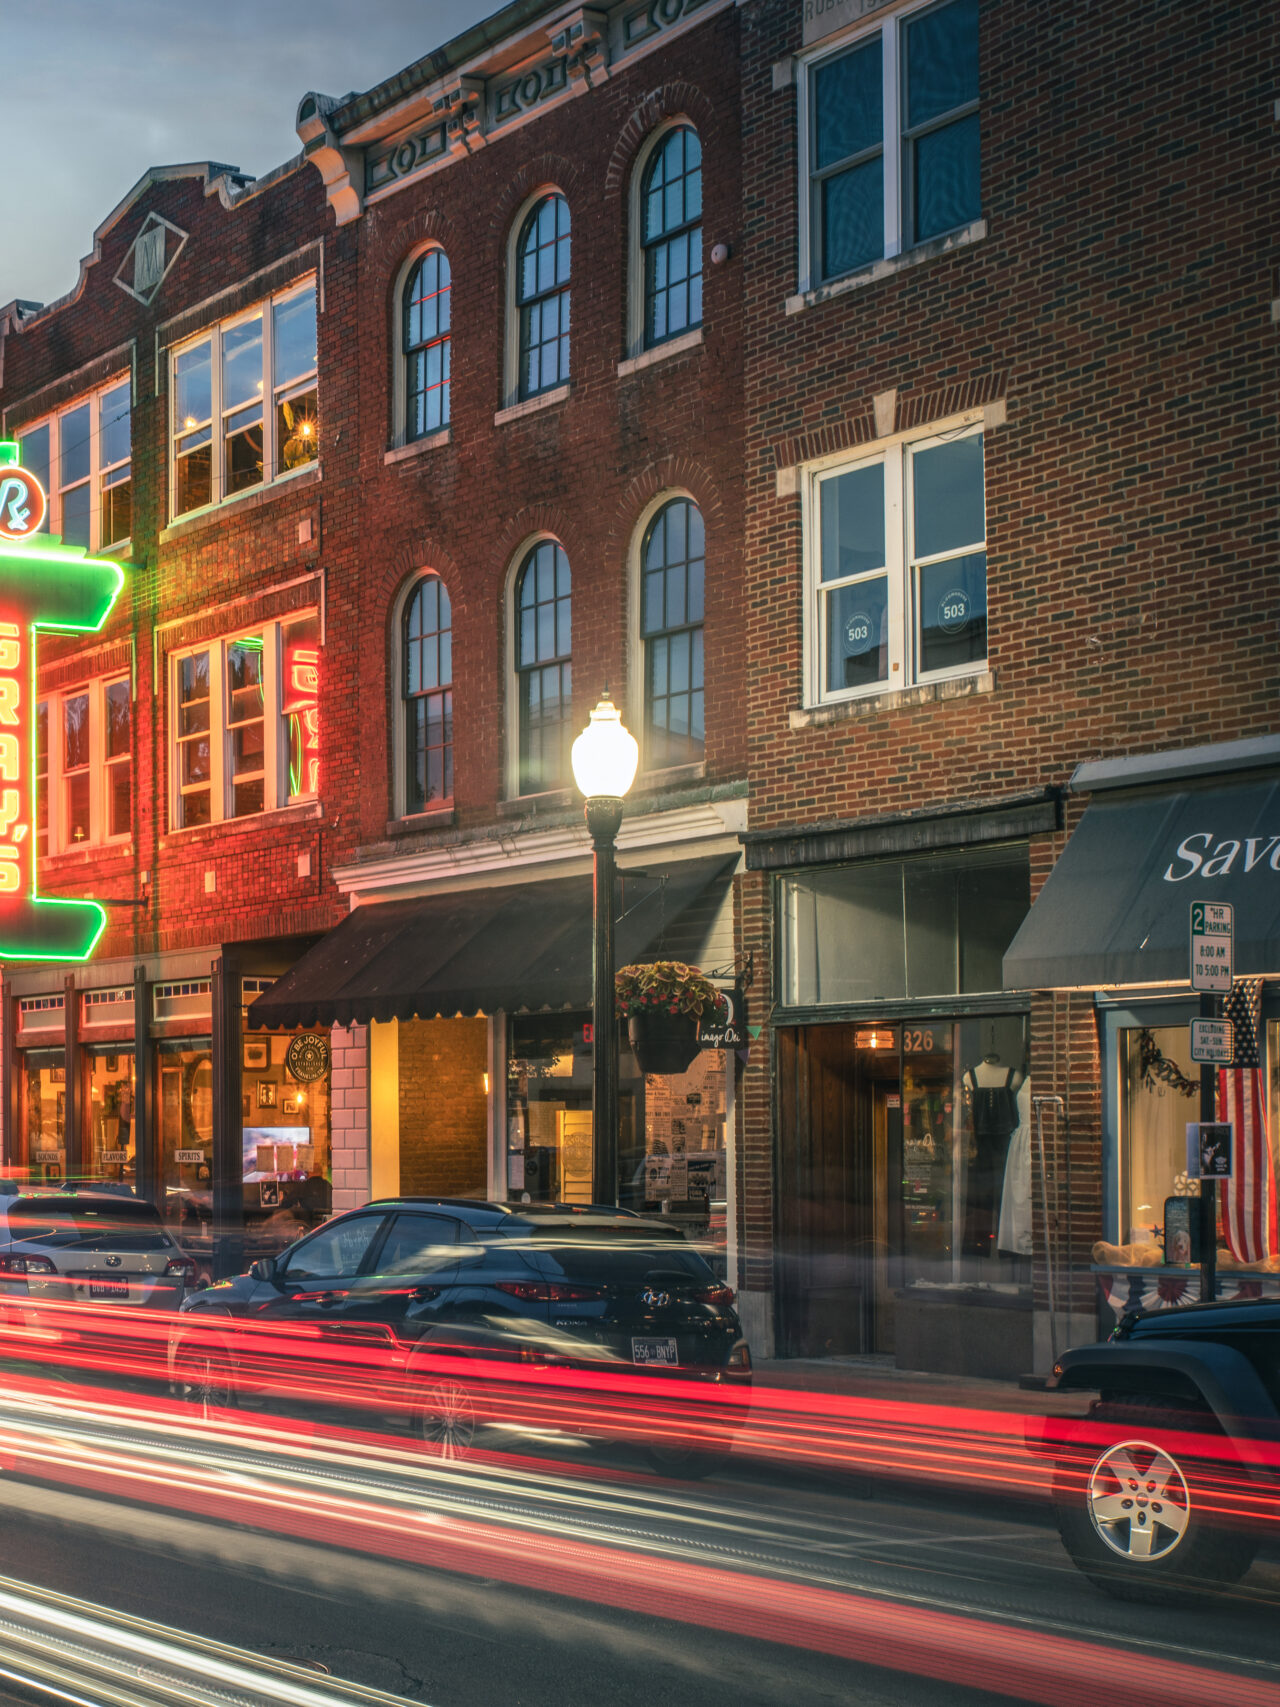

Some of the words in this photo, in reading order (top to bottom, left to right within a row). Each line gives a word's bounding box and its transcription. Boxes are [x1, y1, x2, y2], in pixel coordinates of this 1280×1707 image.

[944, 603, 965, 619] 503
[848, 626, 868, 641] 503
[1194, 908, 1203, 930] 2
[1205, 921, 1231, 934] PARKING
[1200, 945, 1215, 957] 8:00
[1216, 946, 1226, 958] AM
[1196, 963, 1203, 976] TO
[1205, 964, 1219, 976] 5:00
[1221, 965, 1230, 977] PM
[903, 1030, 934, 1051] 326
[304, 1036, 327, 1060] JOYFUL
[37, 1151, 58, 1161] SOUNDS
[103, 1151, 127, 1161] FLAVORS
[178, 1152, 200, 1161] SPIRITS
[634, 1344, 650, 1358] 556
[655, 1344, 675, 1359] BNYP
